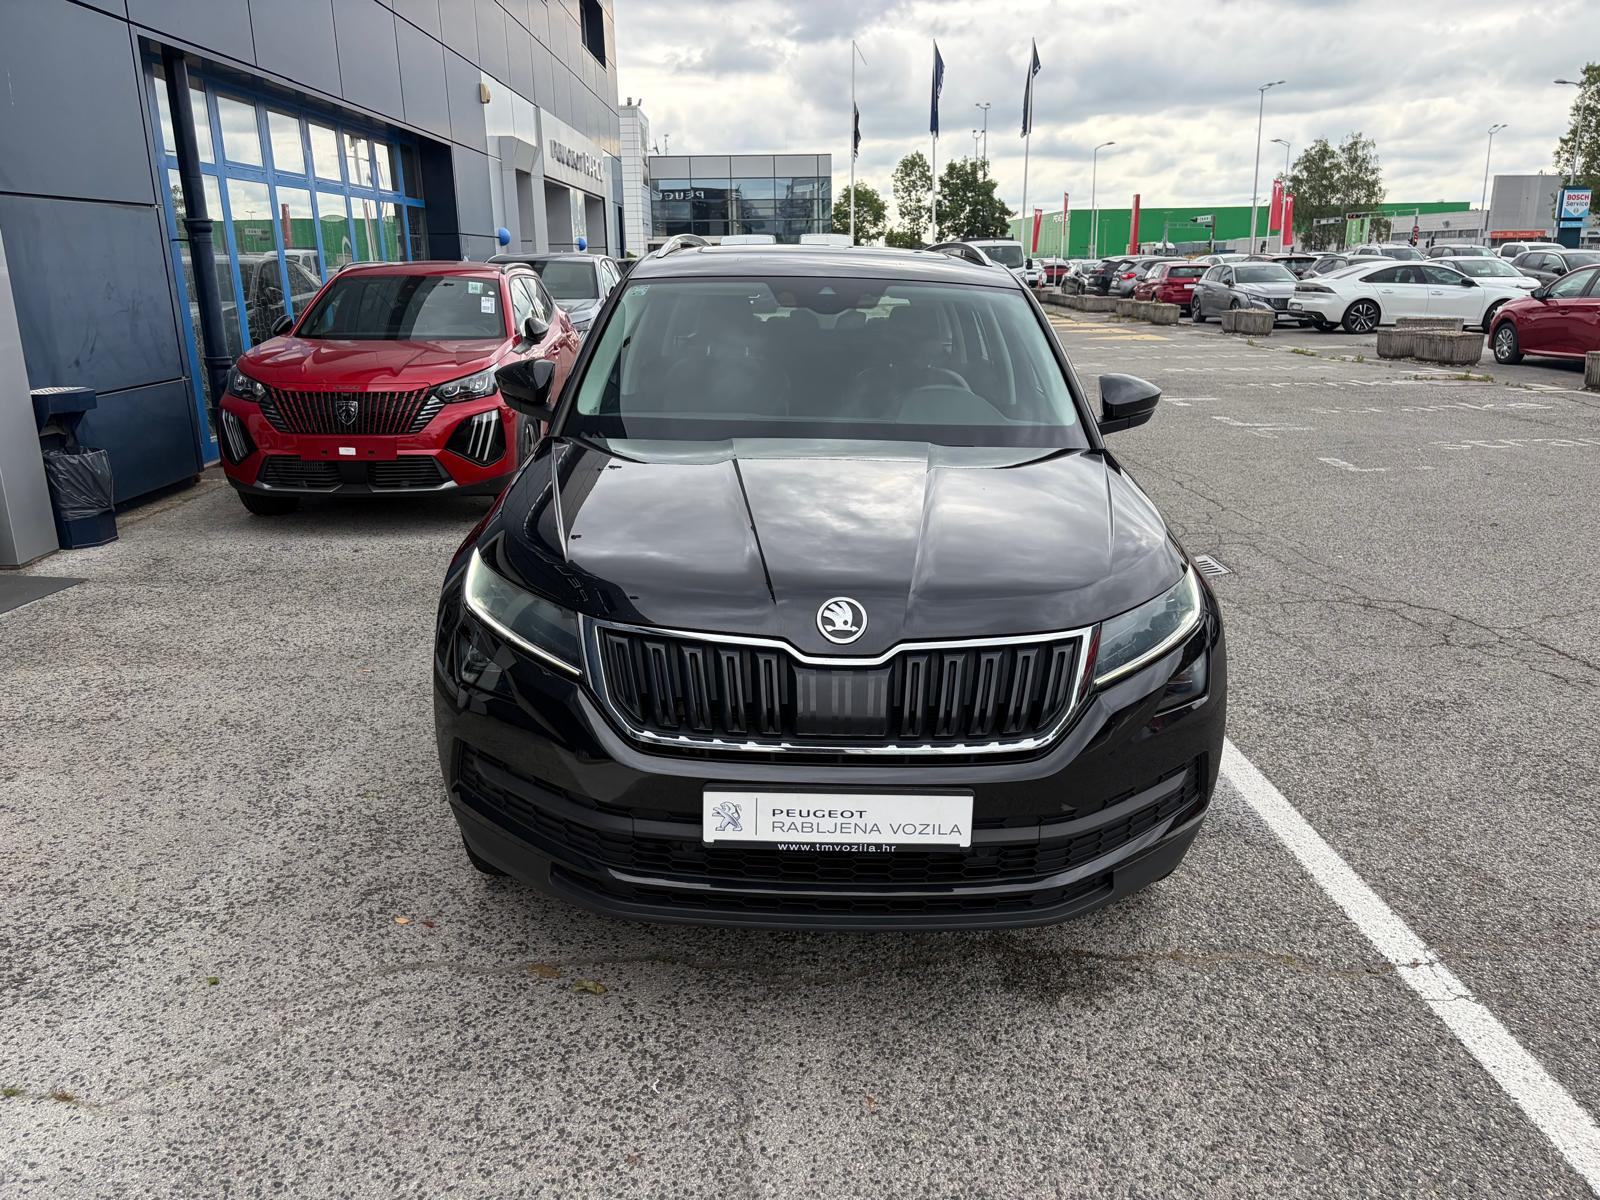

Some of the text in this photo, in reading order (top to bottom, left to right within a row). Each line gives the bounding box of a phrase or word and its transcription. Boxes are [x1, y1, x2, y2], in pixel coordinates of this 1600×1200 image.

[772, 808, 868, 819] PEUGEOT
[772, 821, 962, 836] RABLJENA VOZILA
[778, 843, 897, 852] www.tmvozila.hr
